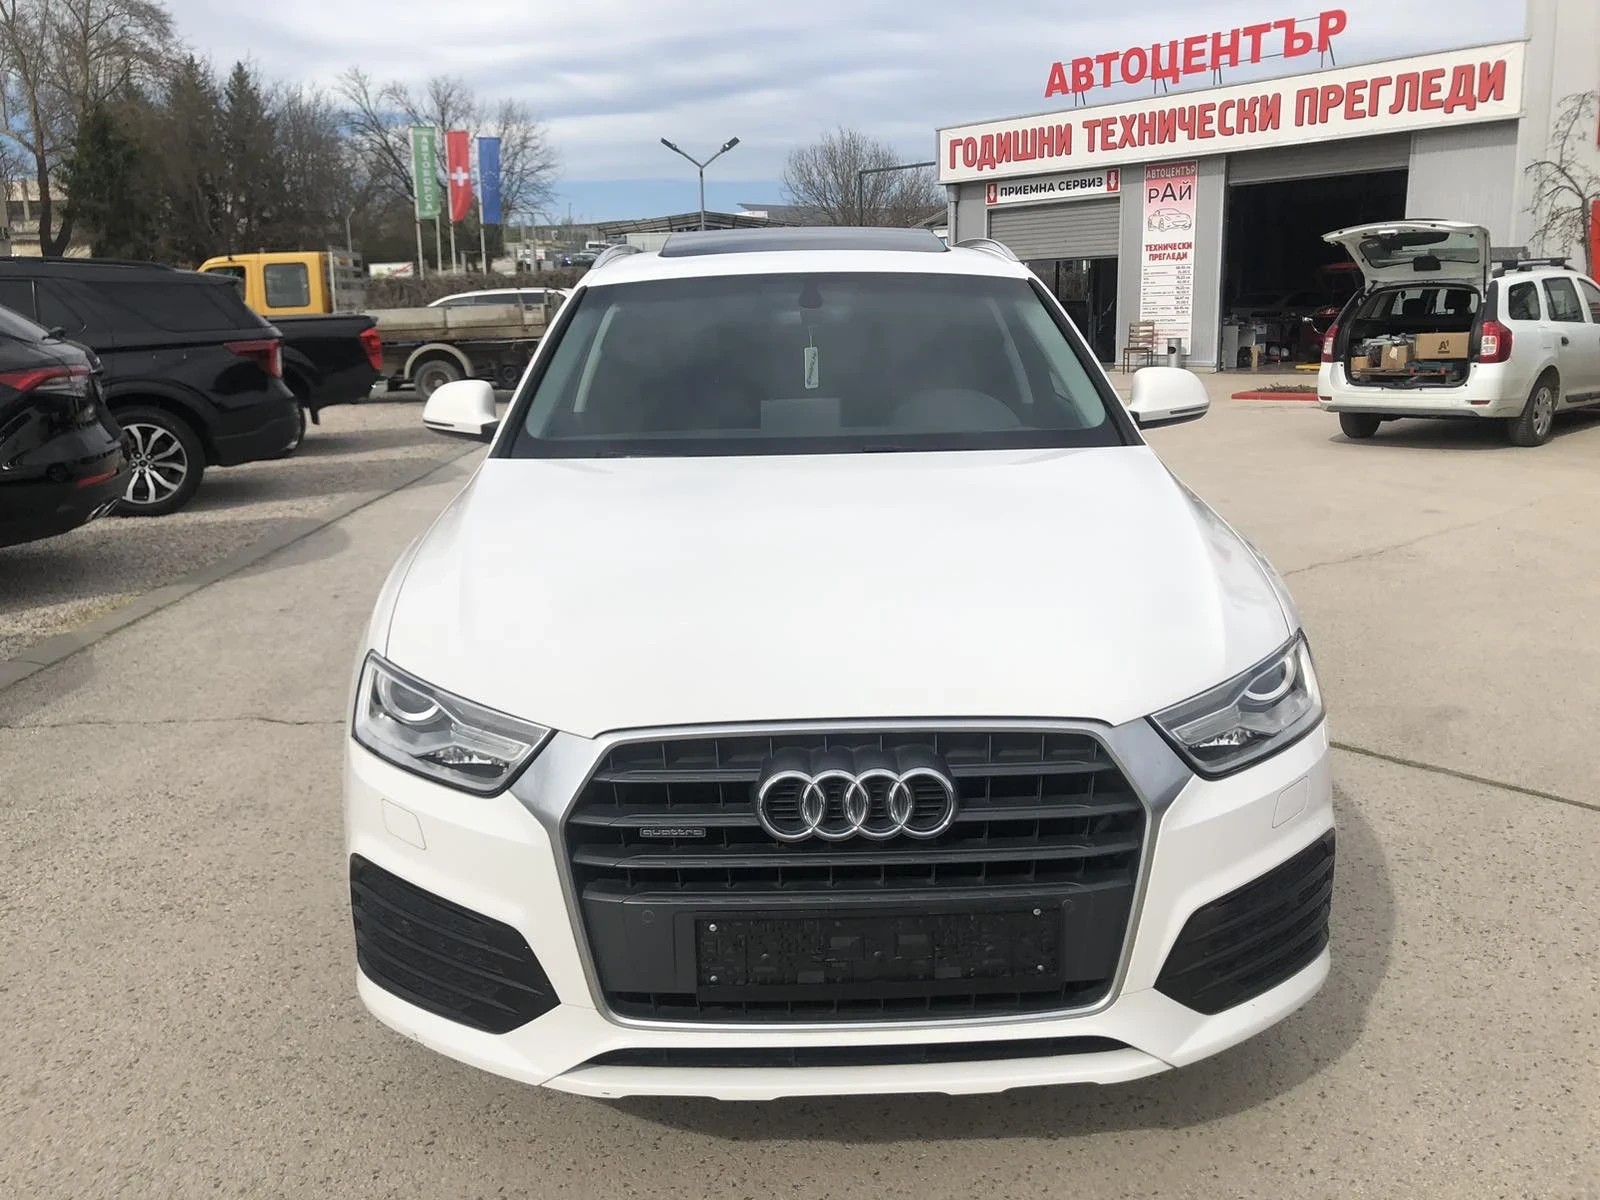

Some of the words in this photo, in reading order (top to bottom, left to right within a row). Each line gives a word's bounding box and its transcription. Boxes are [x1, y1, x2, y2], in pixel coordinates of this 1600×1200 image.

[1045, 9, 1347, 98] АВТОЦЕНТЪР
[949, 123, 1072, 171] ГОДИШНИ
[1082, 92, 1281, 153] ТЕХНИЧЕСКИ
[1295, 60, 1507, 127] ПРЕГЛЕДИ
[1146, 165, 1196, 179] АВТОЦЕНТЪР
[1000, 181, 1056, 197] ПРИЕМНА
[1058, 176, 1103, 192] СЕРВИЗ
[1145, 241, 1192, 252] ТЕХНИЧЕСКИ
[1149, 251, 1188, 261] ПРЕГЛЕДИ
[642, 828, 703, 836] quattro
